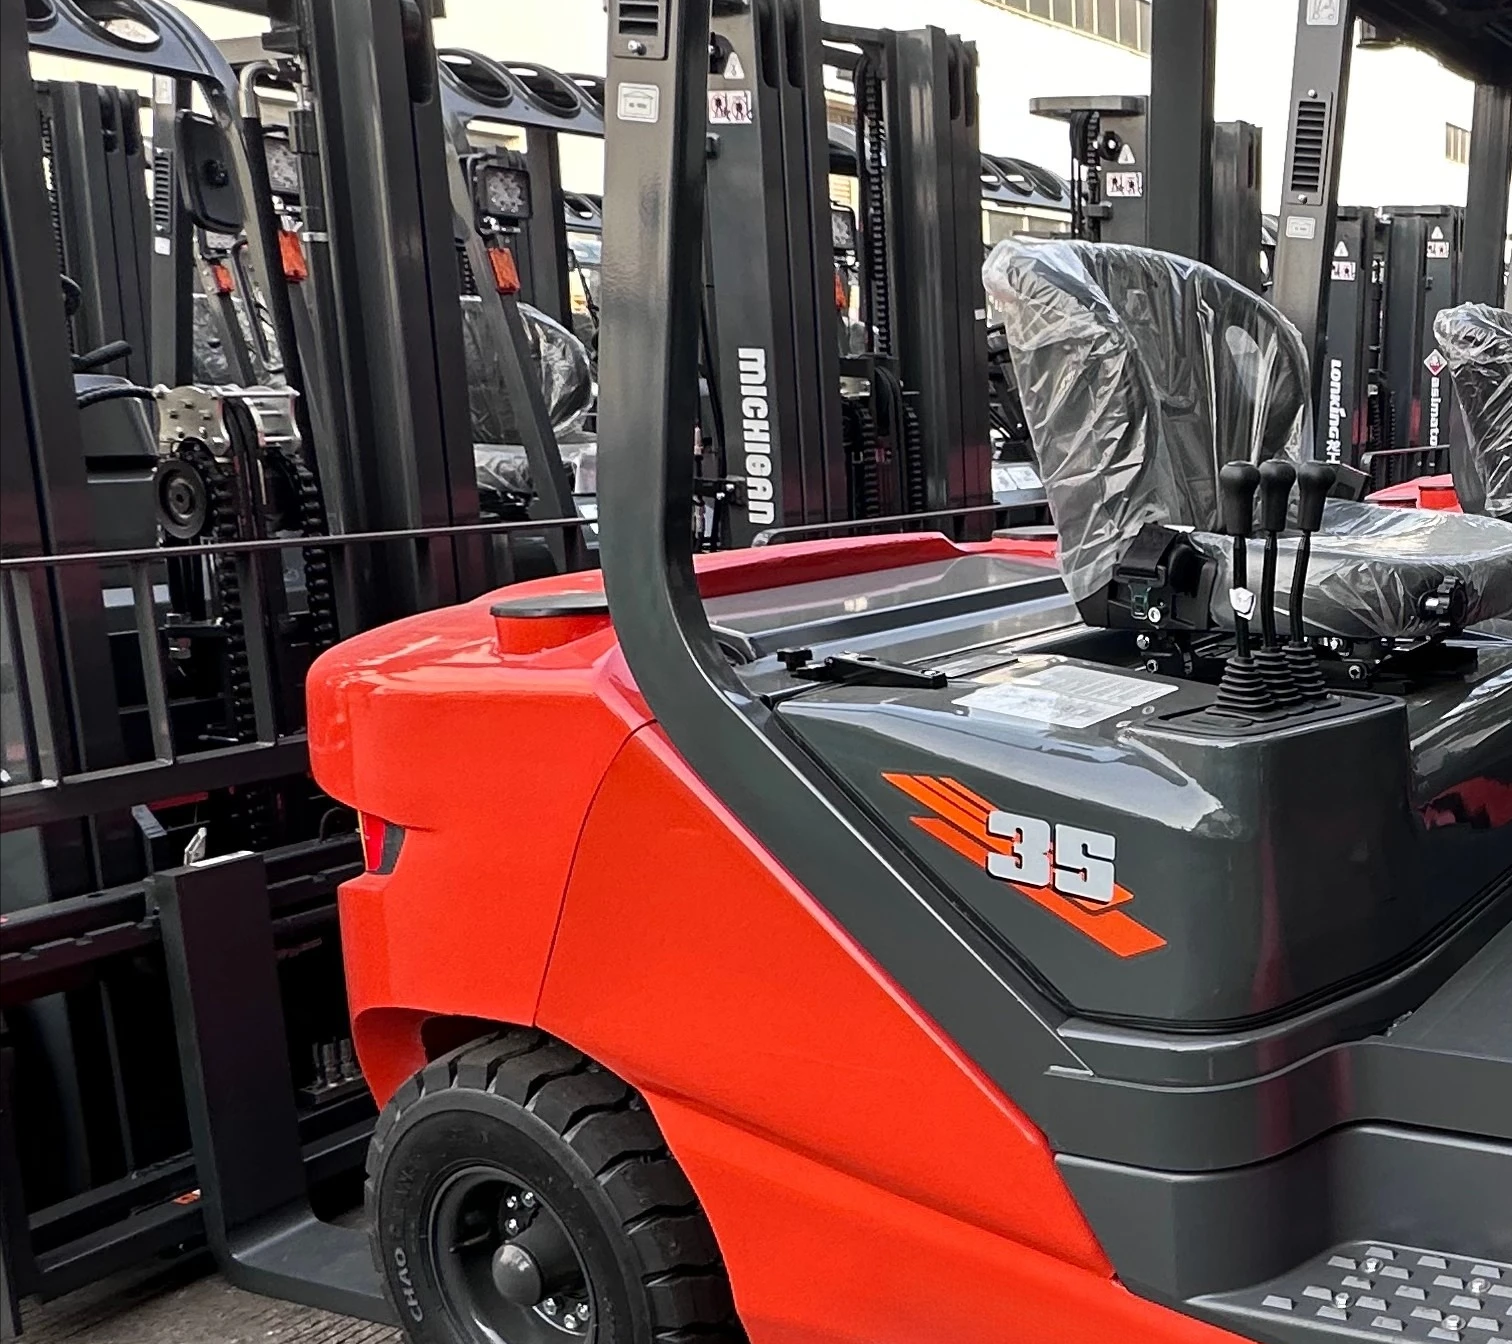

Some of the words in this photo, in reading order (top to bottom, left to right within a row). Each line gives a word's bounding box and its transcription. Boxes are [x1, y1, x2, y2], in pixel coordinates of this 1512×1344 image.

[738, 347, 775, 525] MICHIGAN
[987, 810, 1117, 904] 35
[394, 1247, 424, 1323] CHAO
